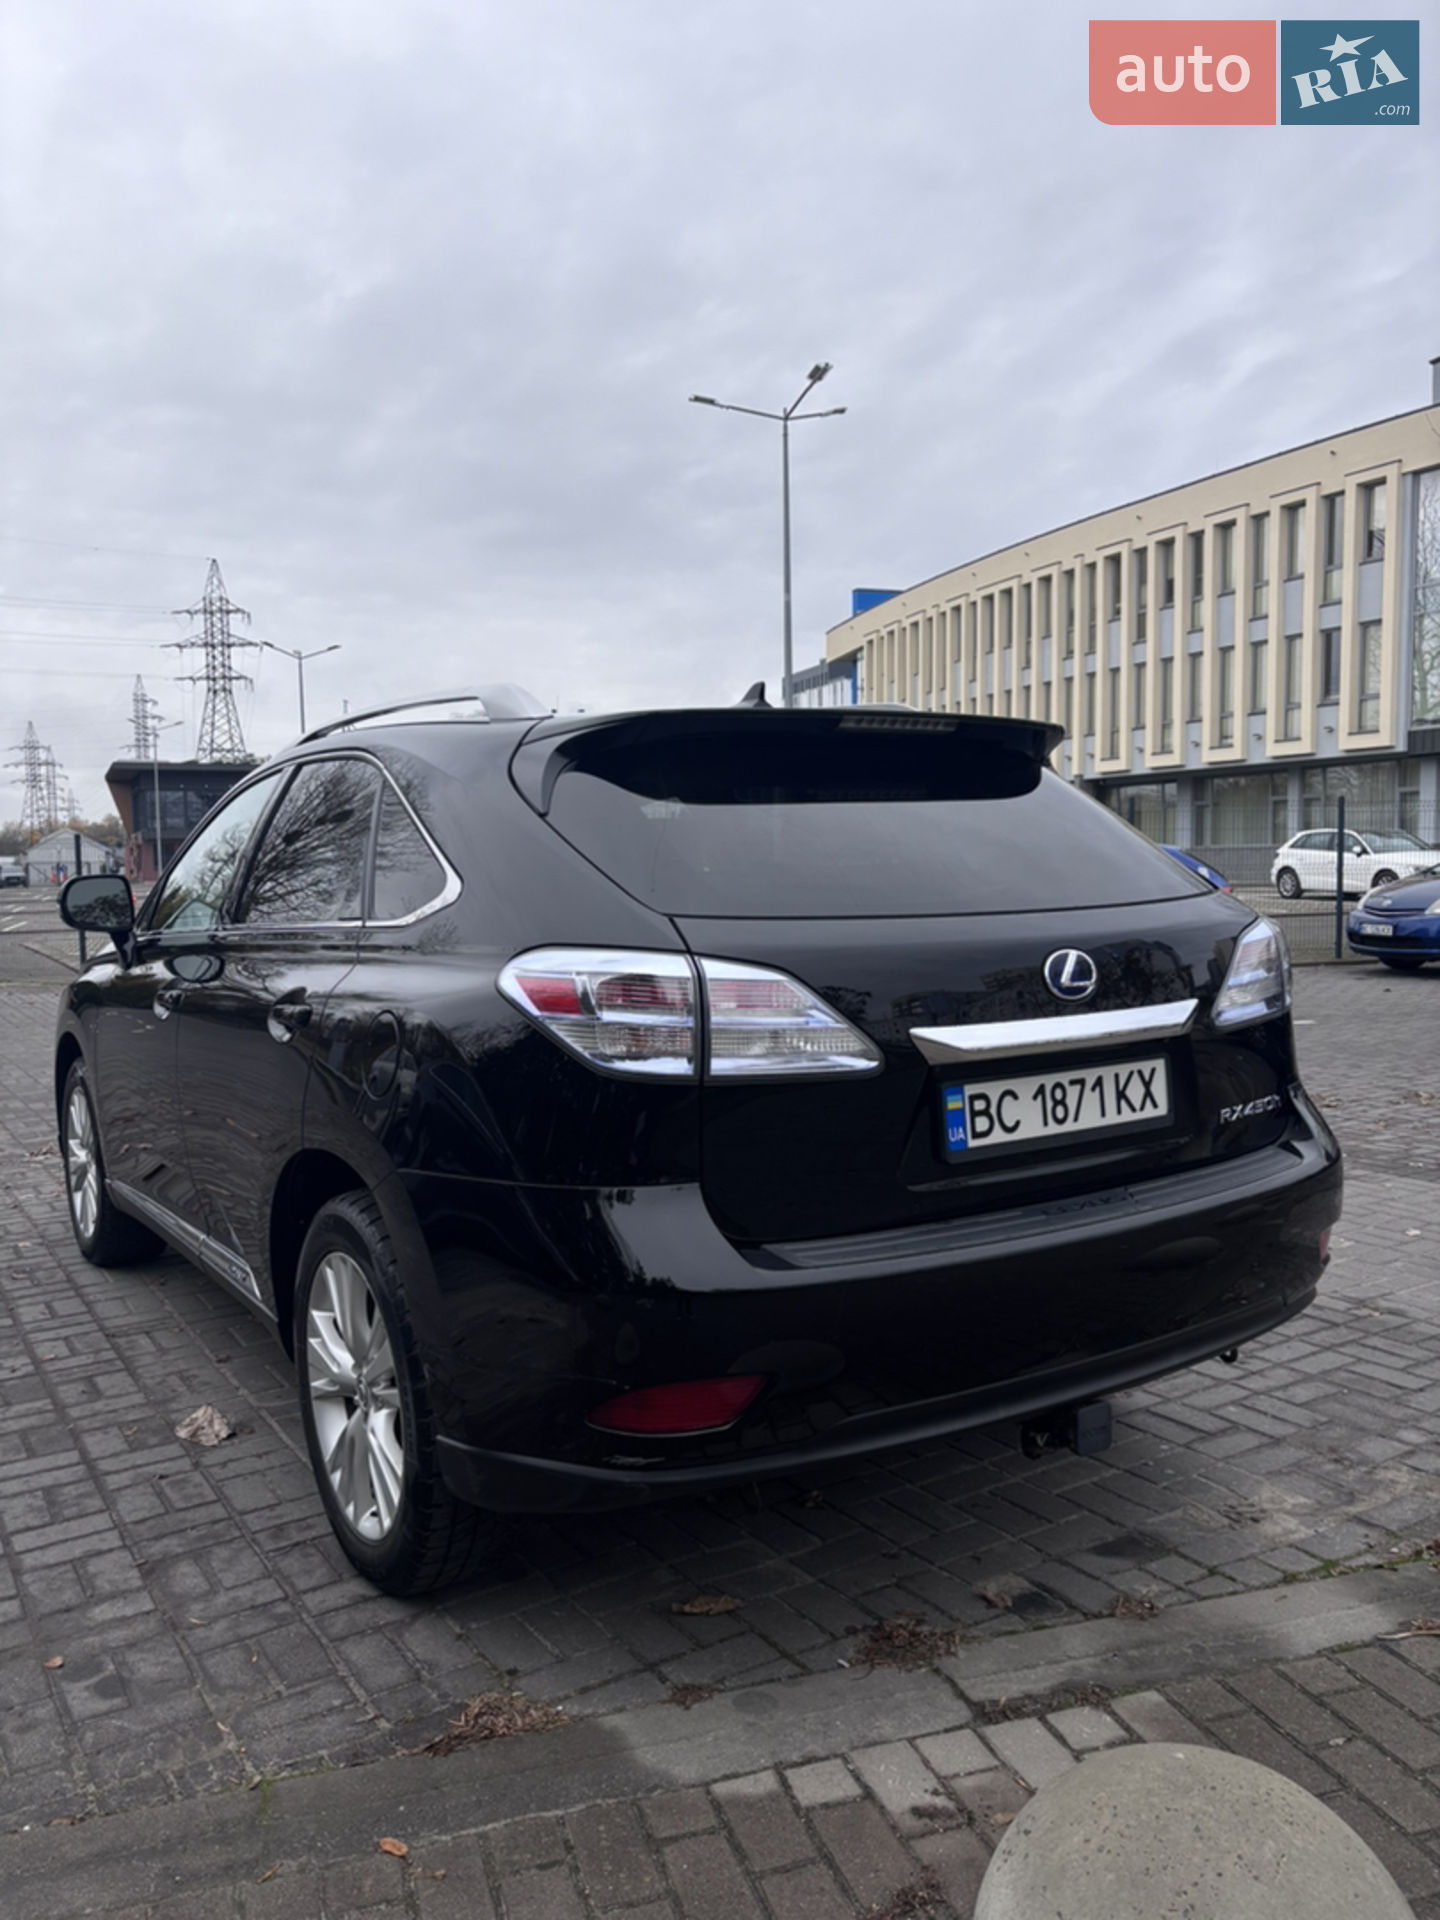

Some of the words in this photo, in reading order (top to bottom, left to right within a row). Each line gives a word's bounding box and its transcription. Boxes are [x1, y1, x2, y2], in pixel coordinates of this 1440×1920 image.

[968, 1088, 1021, 1141] BC
[1032, 1074, 1106, 1128] 1871
[1113, 1067, 1159, 1116] KX
[949, 1127, 966, 1142] UA
